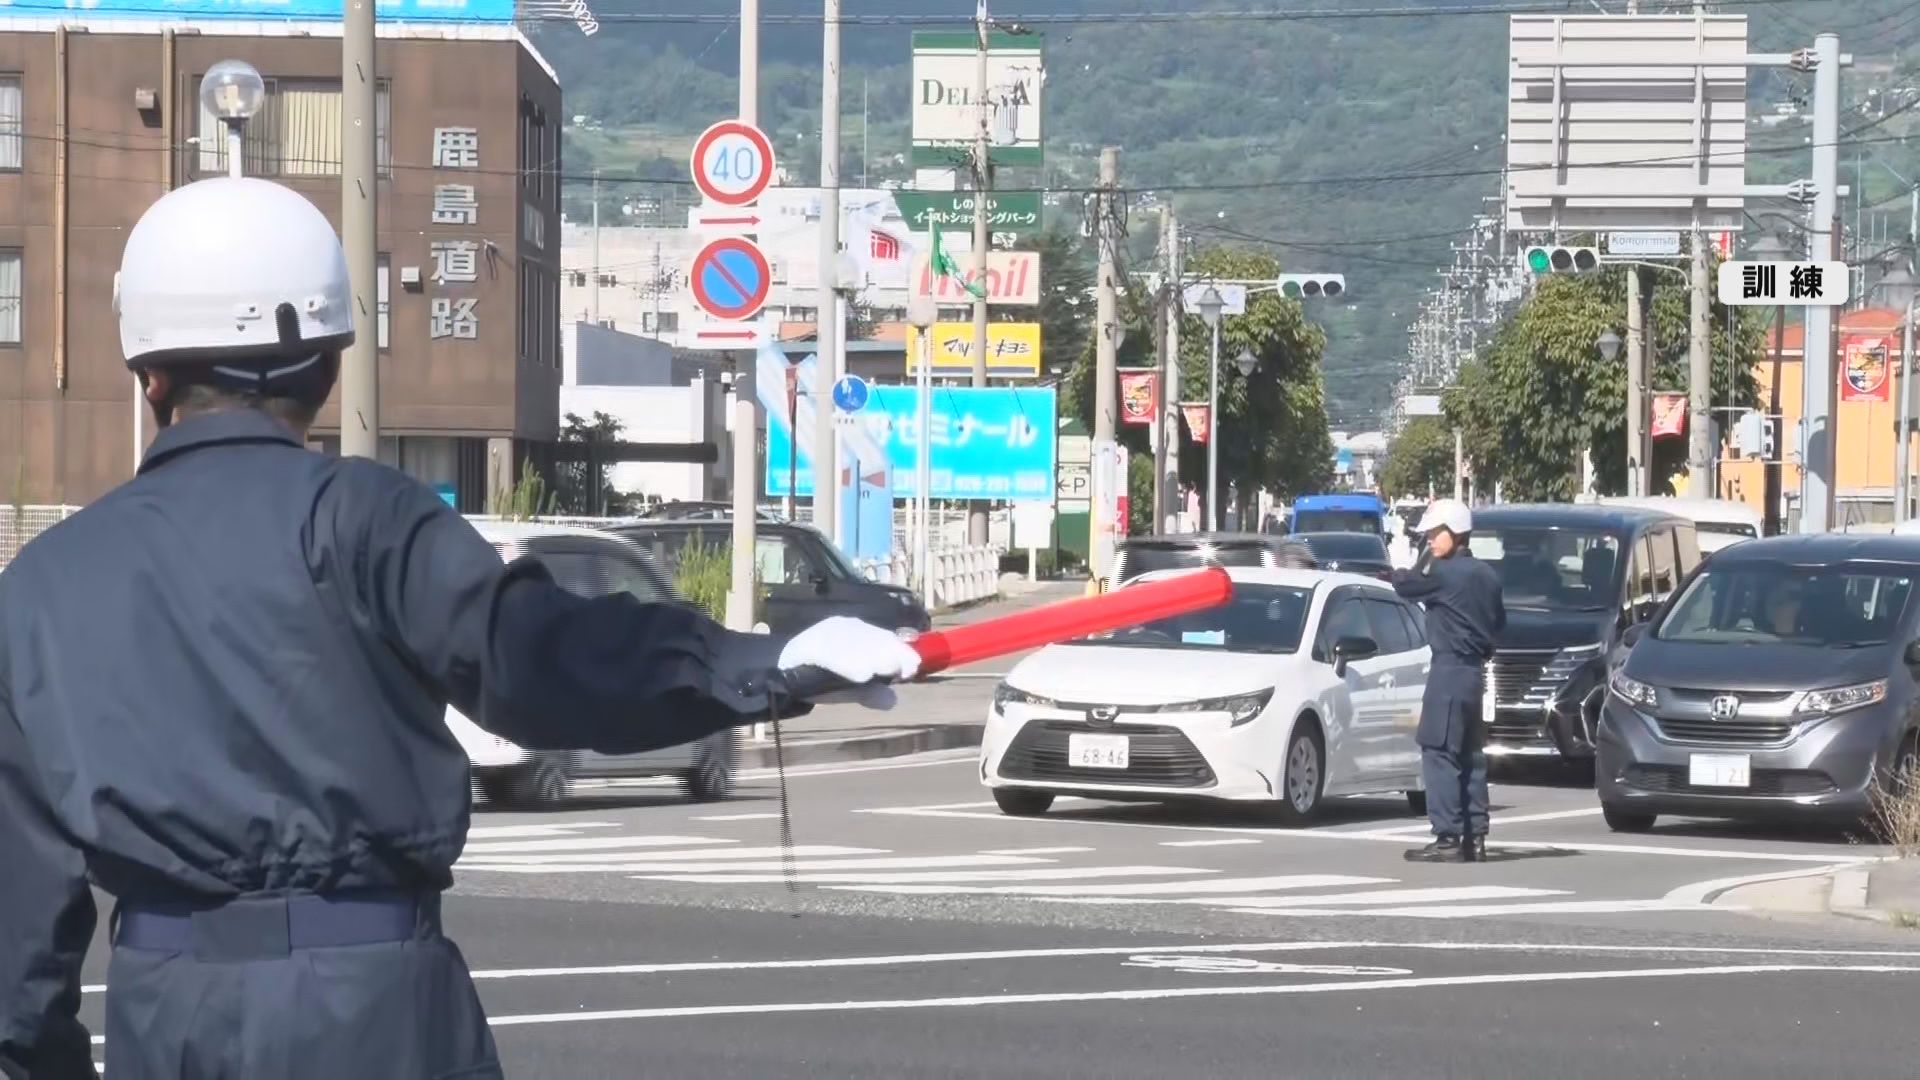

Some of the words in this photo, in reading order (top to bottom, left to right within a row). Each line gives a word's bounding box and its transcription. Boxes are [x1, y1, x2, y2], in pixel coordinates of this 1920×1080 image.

[712, 146, 754, 181] 40
[953, 198, 998, 211] しのい
[430, 126, 479, 340] 鹿島道路
[1073, 477, 1086, 493] P
